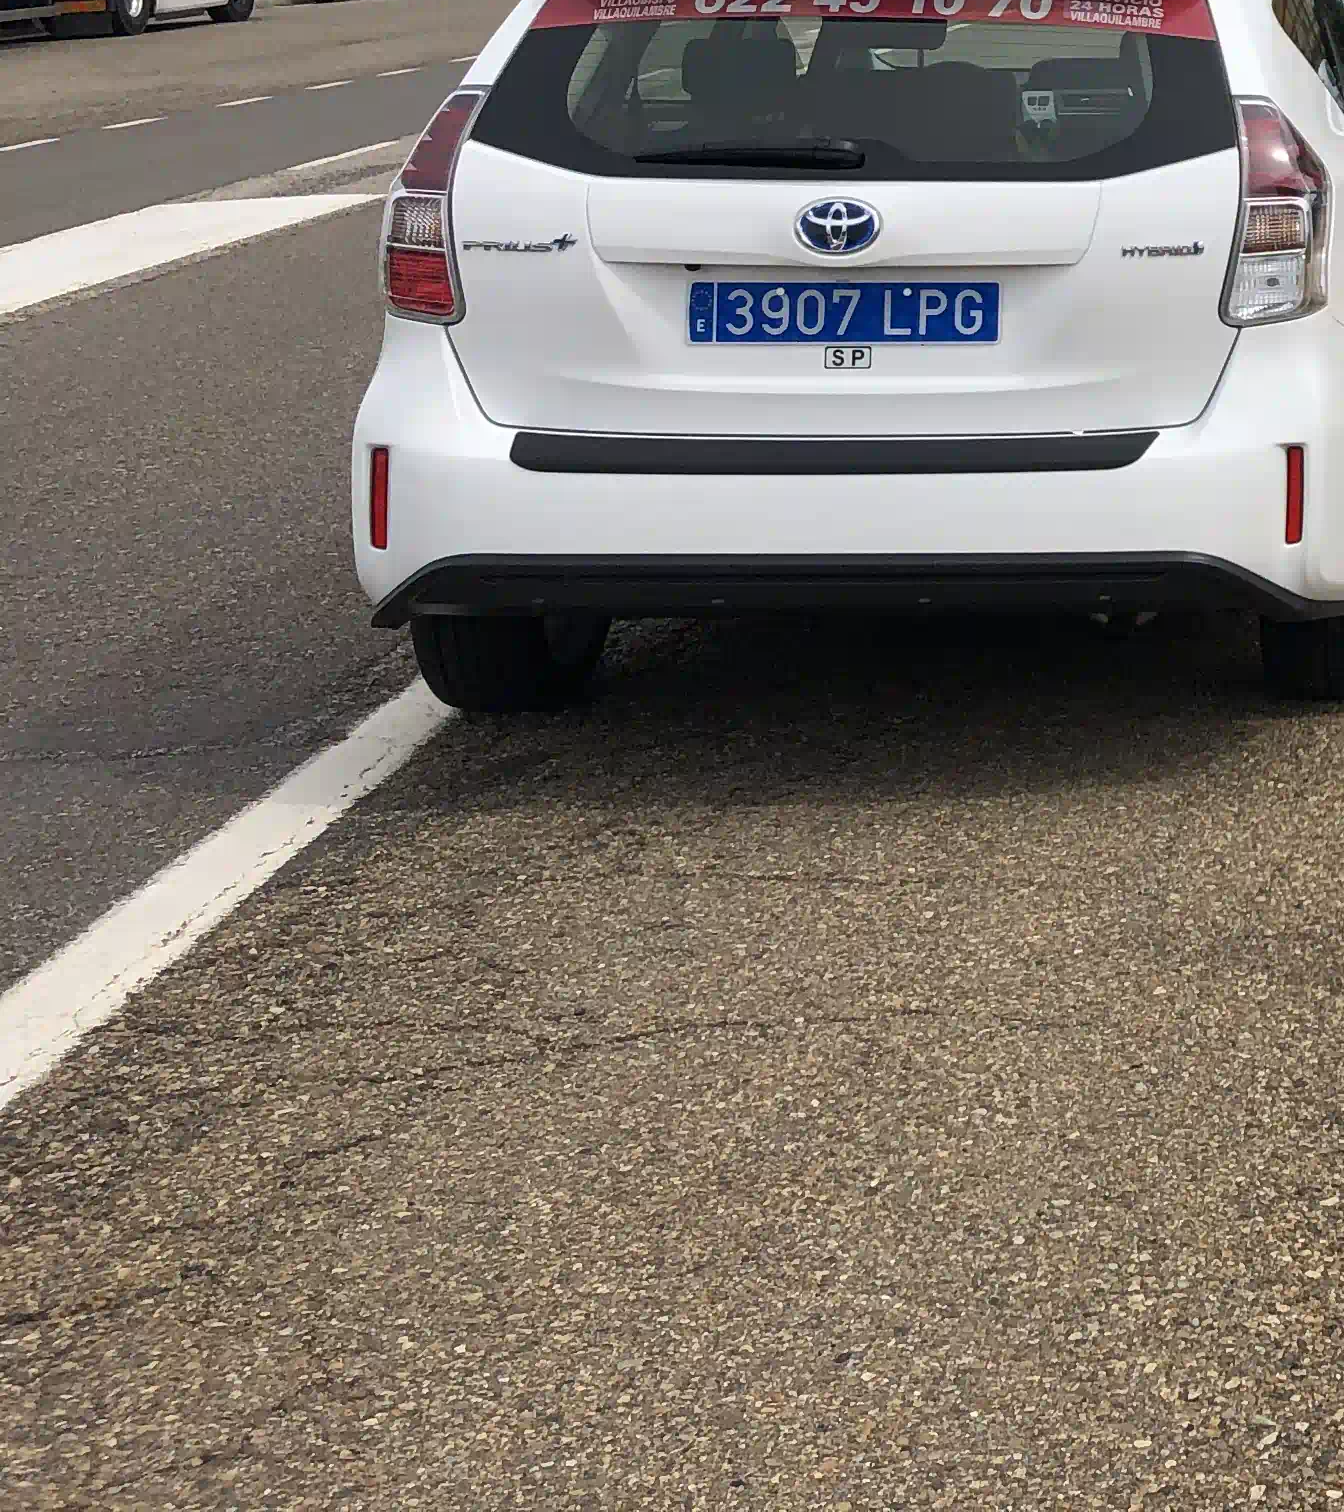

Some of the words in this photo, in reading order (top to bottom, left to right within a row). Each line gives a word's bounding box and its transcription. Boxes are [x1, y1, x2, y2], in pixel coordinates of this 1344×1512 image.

[593, 4, 676, 20] VILLAQUILAMBRE
[1070, 0, 1093, 12] 24
[1102, 1, 1165, 18] HORAS
[1070, 10, 1162, 29] VILLAQUILAMBRE
[725, 289, 862, 336] 3907
[883, 289, 984, 336] LPG
[696, 319, 706, 333] E
